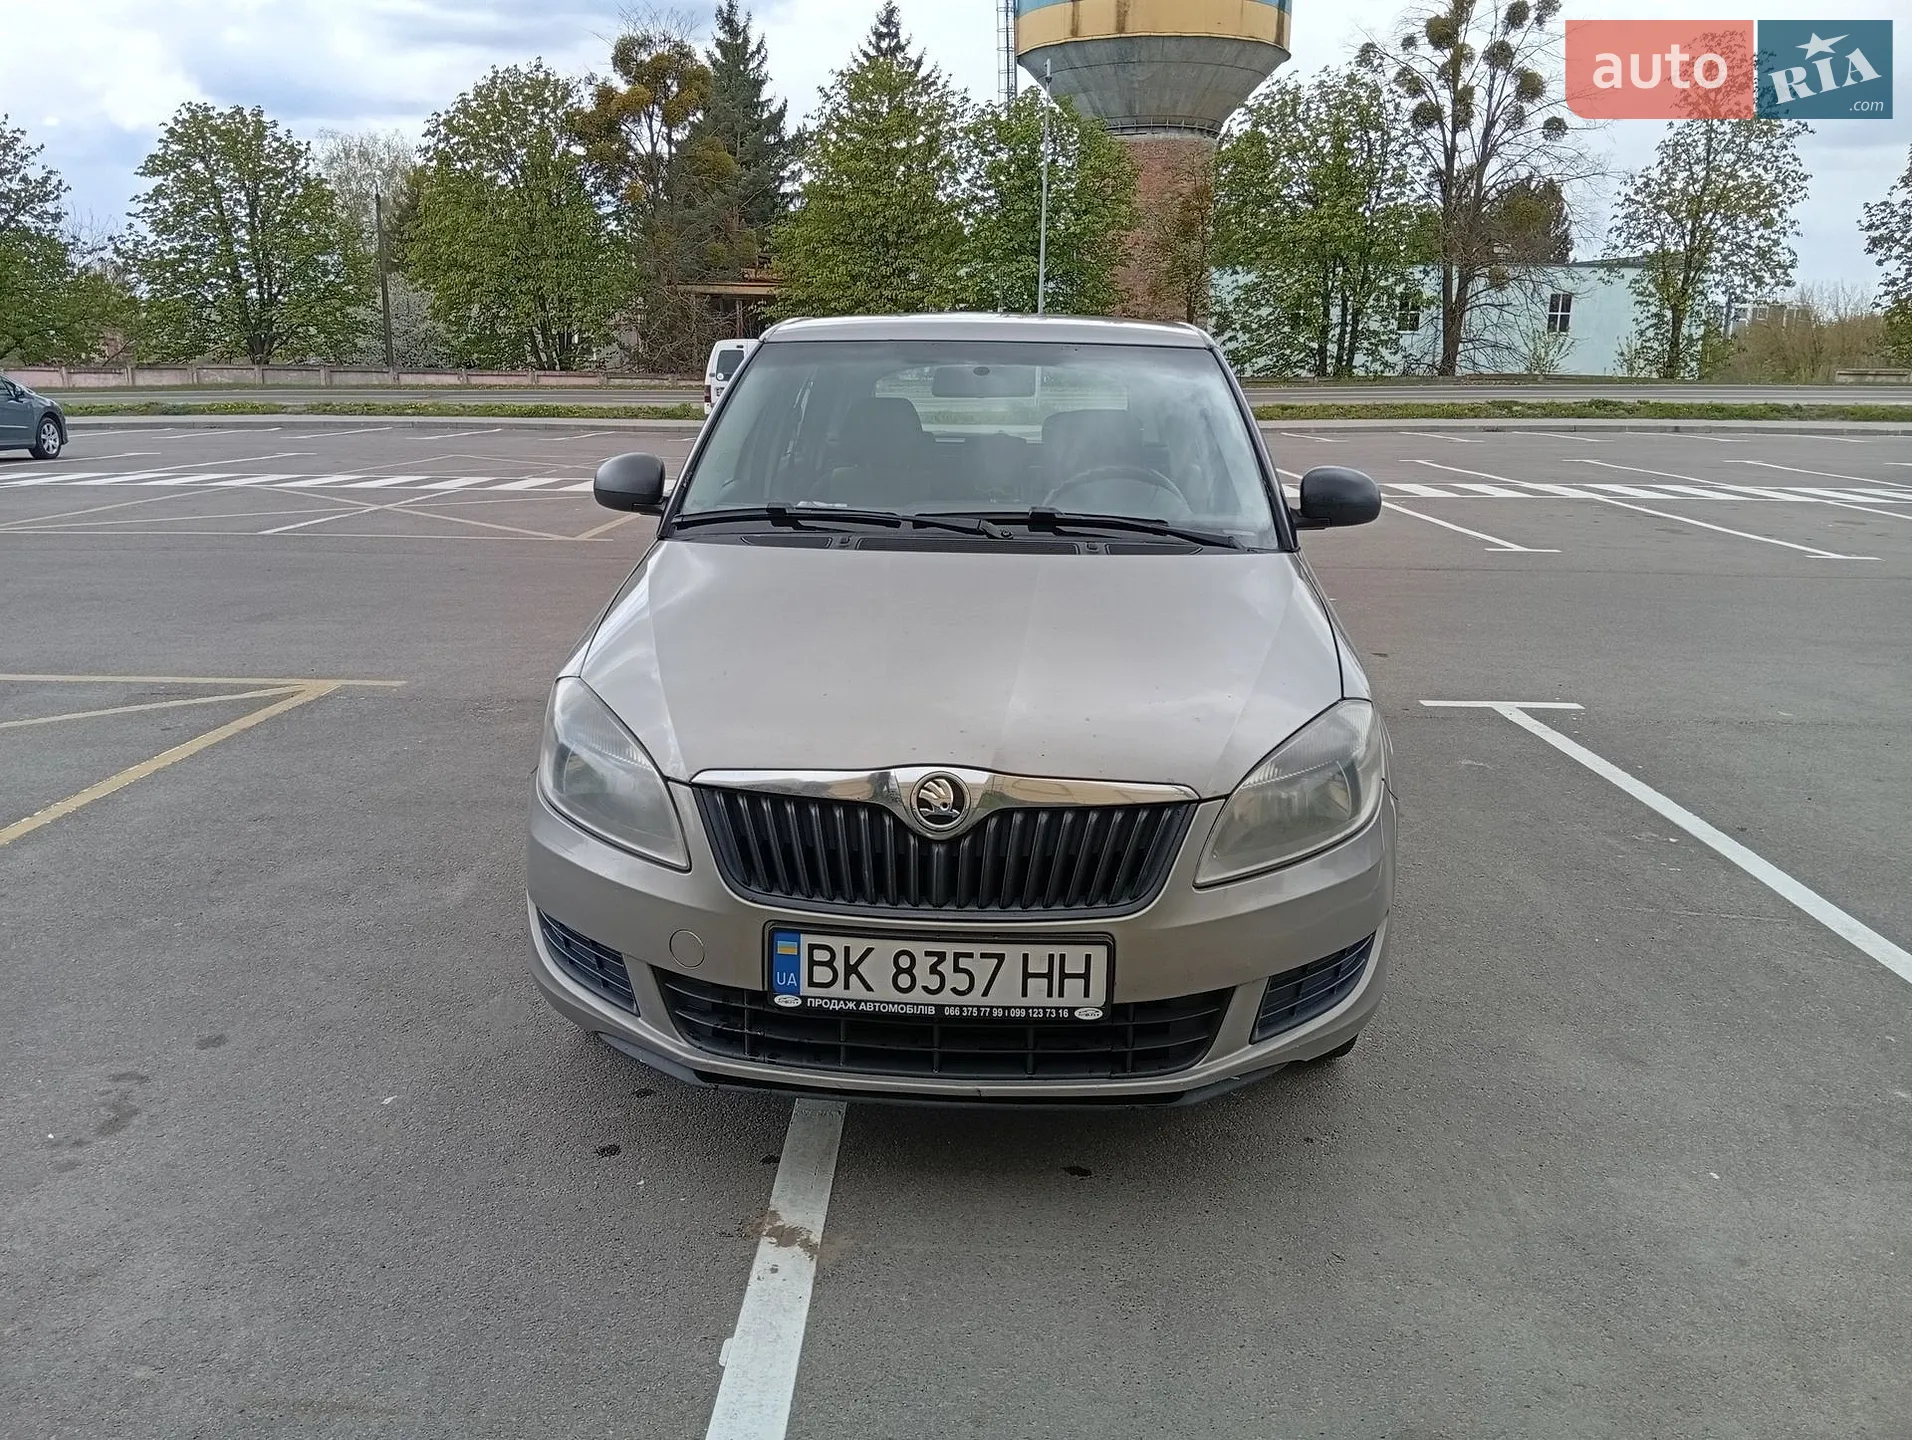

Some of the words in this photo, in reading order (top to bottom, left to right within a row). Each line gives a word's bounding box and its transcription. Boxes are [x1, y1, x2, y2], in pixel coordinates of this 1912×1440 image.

[776, 971, 798, 987] UA
[807, 943, 875, 993] BK
[891, 949, 1006, 998] 8357
[1021, 953, 1092, 999] HH
[807, 998, 857, 1011] ПРОДАЖ
[858, 1003, 936, 1015] АВТОМОБІЛІВ
[944, 1006, 960, 1016] 066
[962, 1007, 978, 1016] 375
[980, 1007, 990, 1017] 77
[992, 1008, 1003, 1017] 99
[1010, 1008, 1026, 1018] 099
[1028, 1008, 1044, 1018] 123
[1045, 1009, 1056, 1018] 73
[1058, 1009, 1069, 1018] 16
